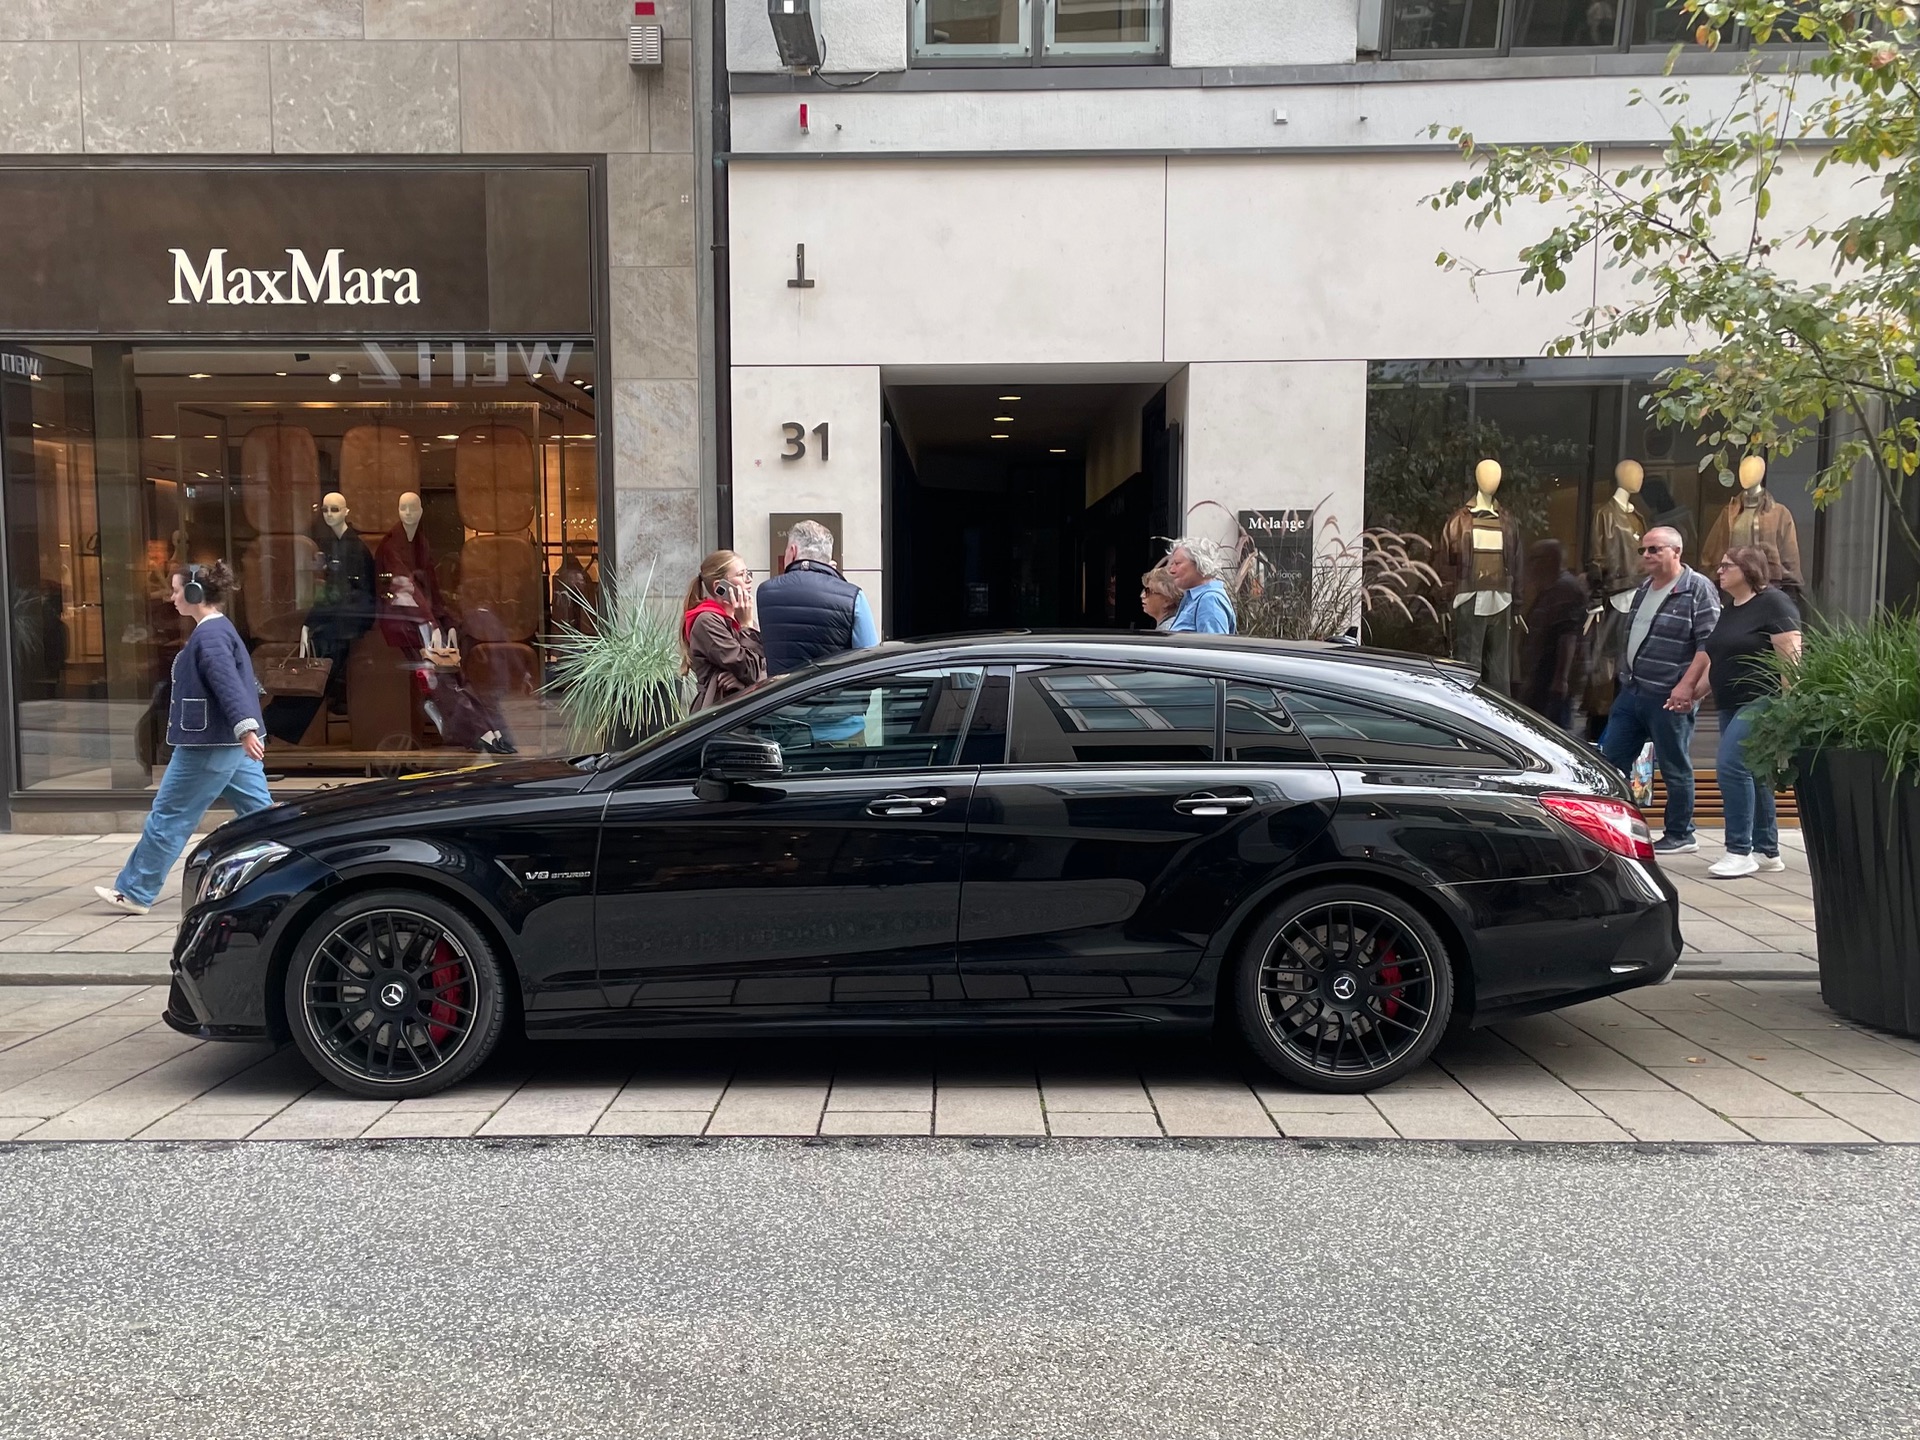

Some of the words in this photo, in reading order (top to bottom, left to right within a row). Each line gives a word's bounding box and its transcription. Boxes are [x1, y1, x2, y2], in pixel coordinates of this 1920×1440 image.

[168, 249, 420, 305] MaxMara
[780, 422, 829, 461] 31
[525, 871, 549, 880] V8
[551, 871, 591, 879] BITURBO
